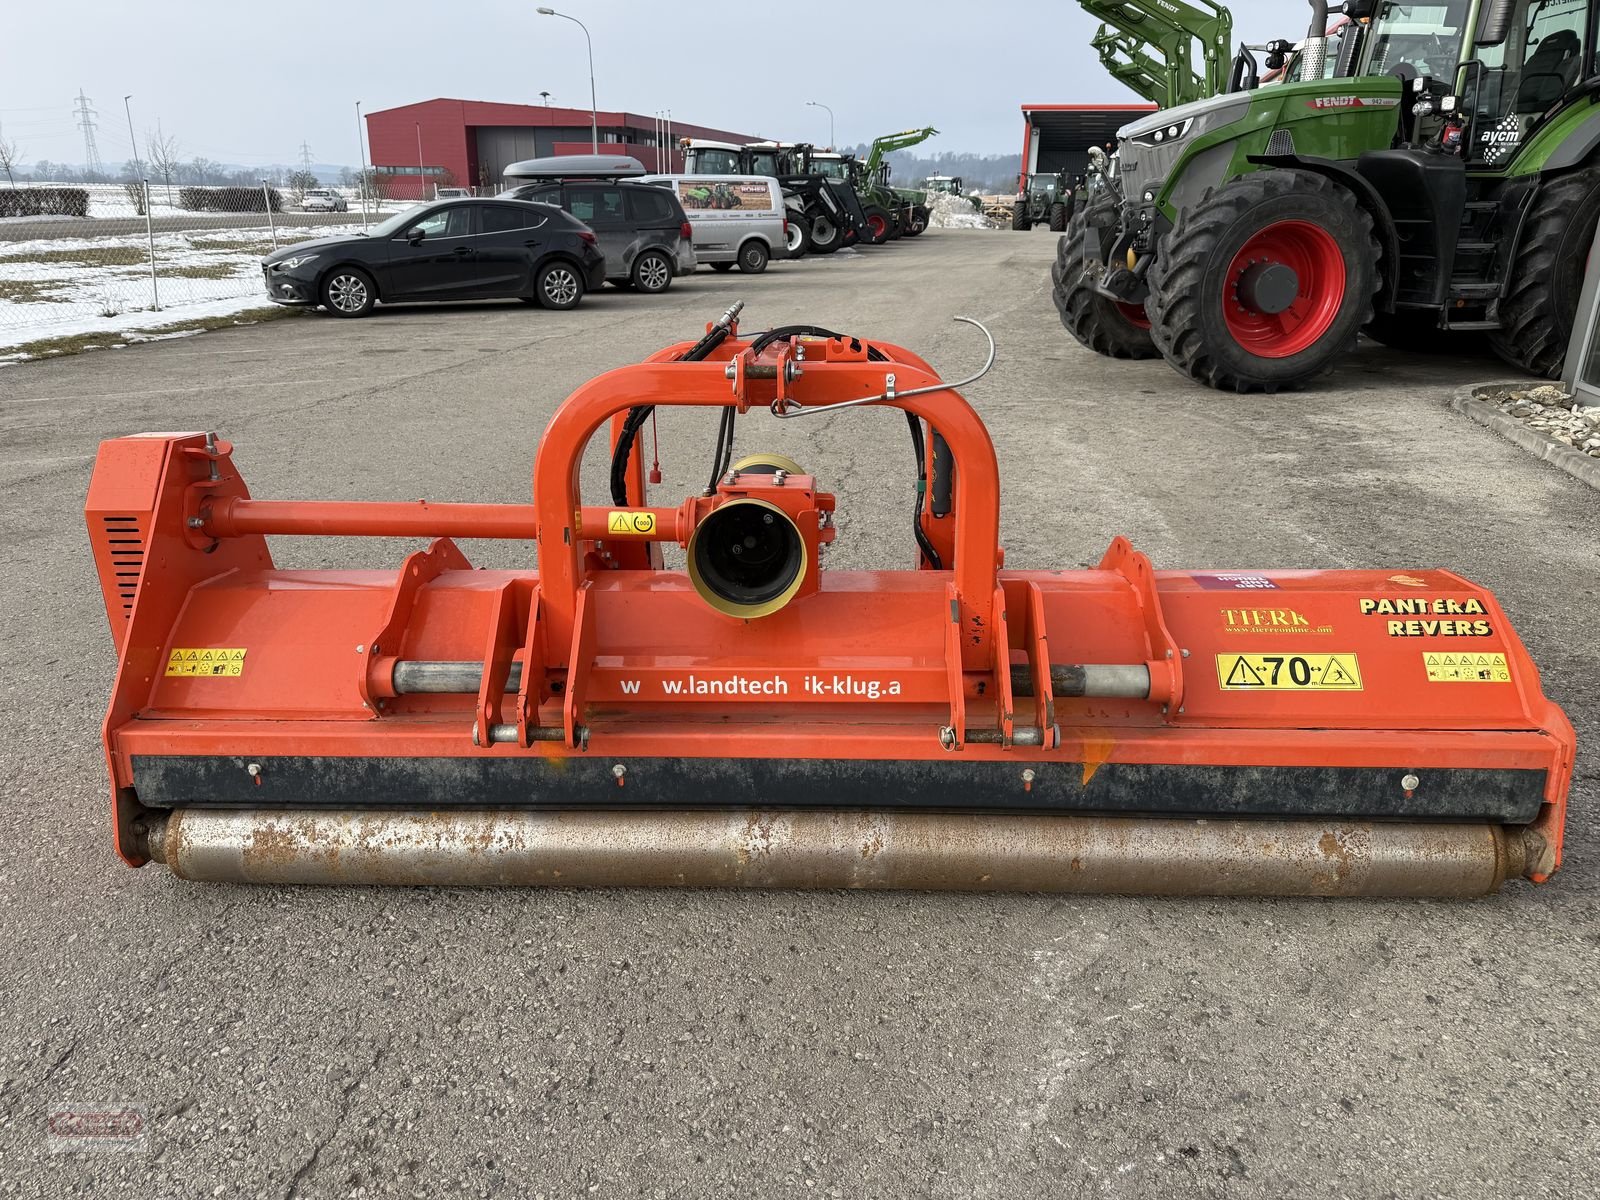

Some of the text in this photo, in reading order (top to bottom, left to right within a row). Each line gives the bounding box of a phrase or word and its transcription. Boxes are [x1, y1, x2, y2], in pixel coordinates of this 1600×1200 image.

[1315, 96, 1357, 107] FENDT
[1481, 131, 1519, 145] aycm
[1359, 598, 1488, 615] PANTERA
[1387, 620, 1493, 637] REVERS
[1262, 656, 1311, 686] 70
